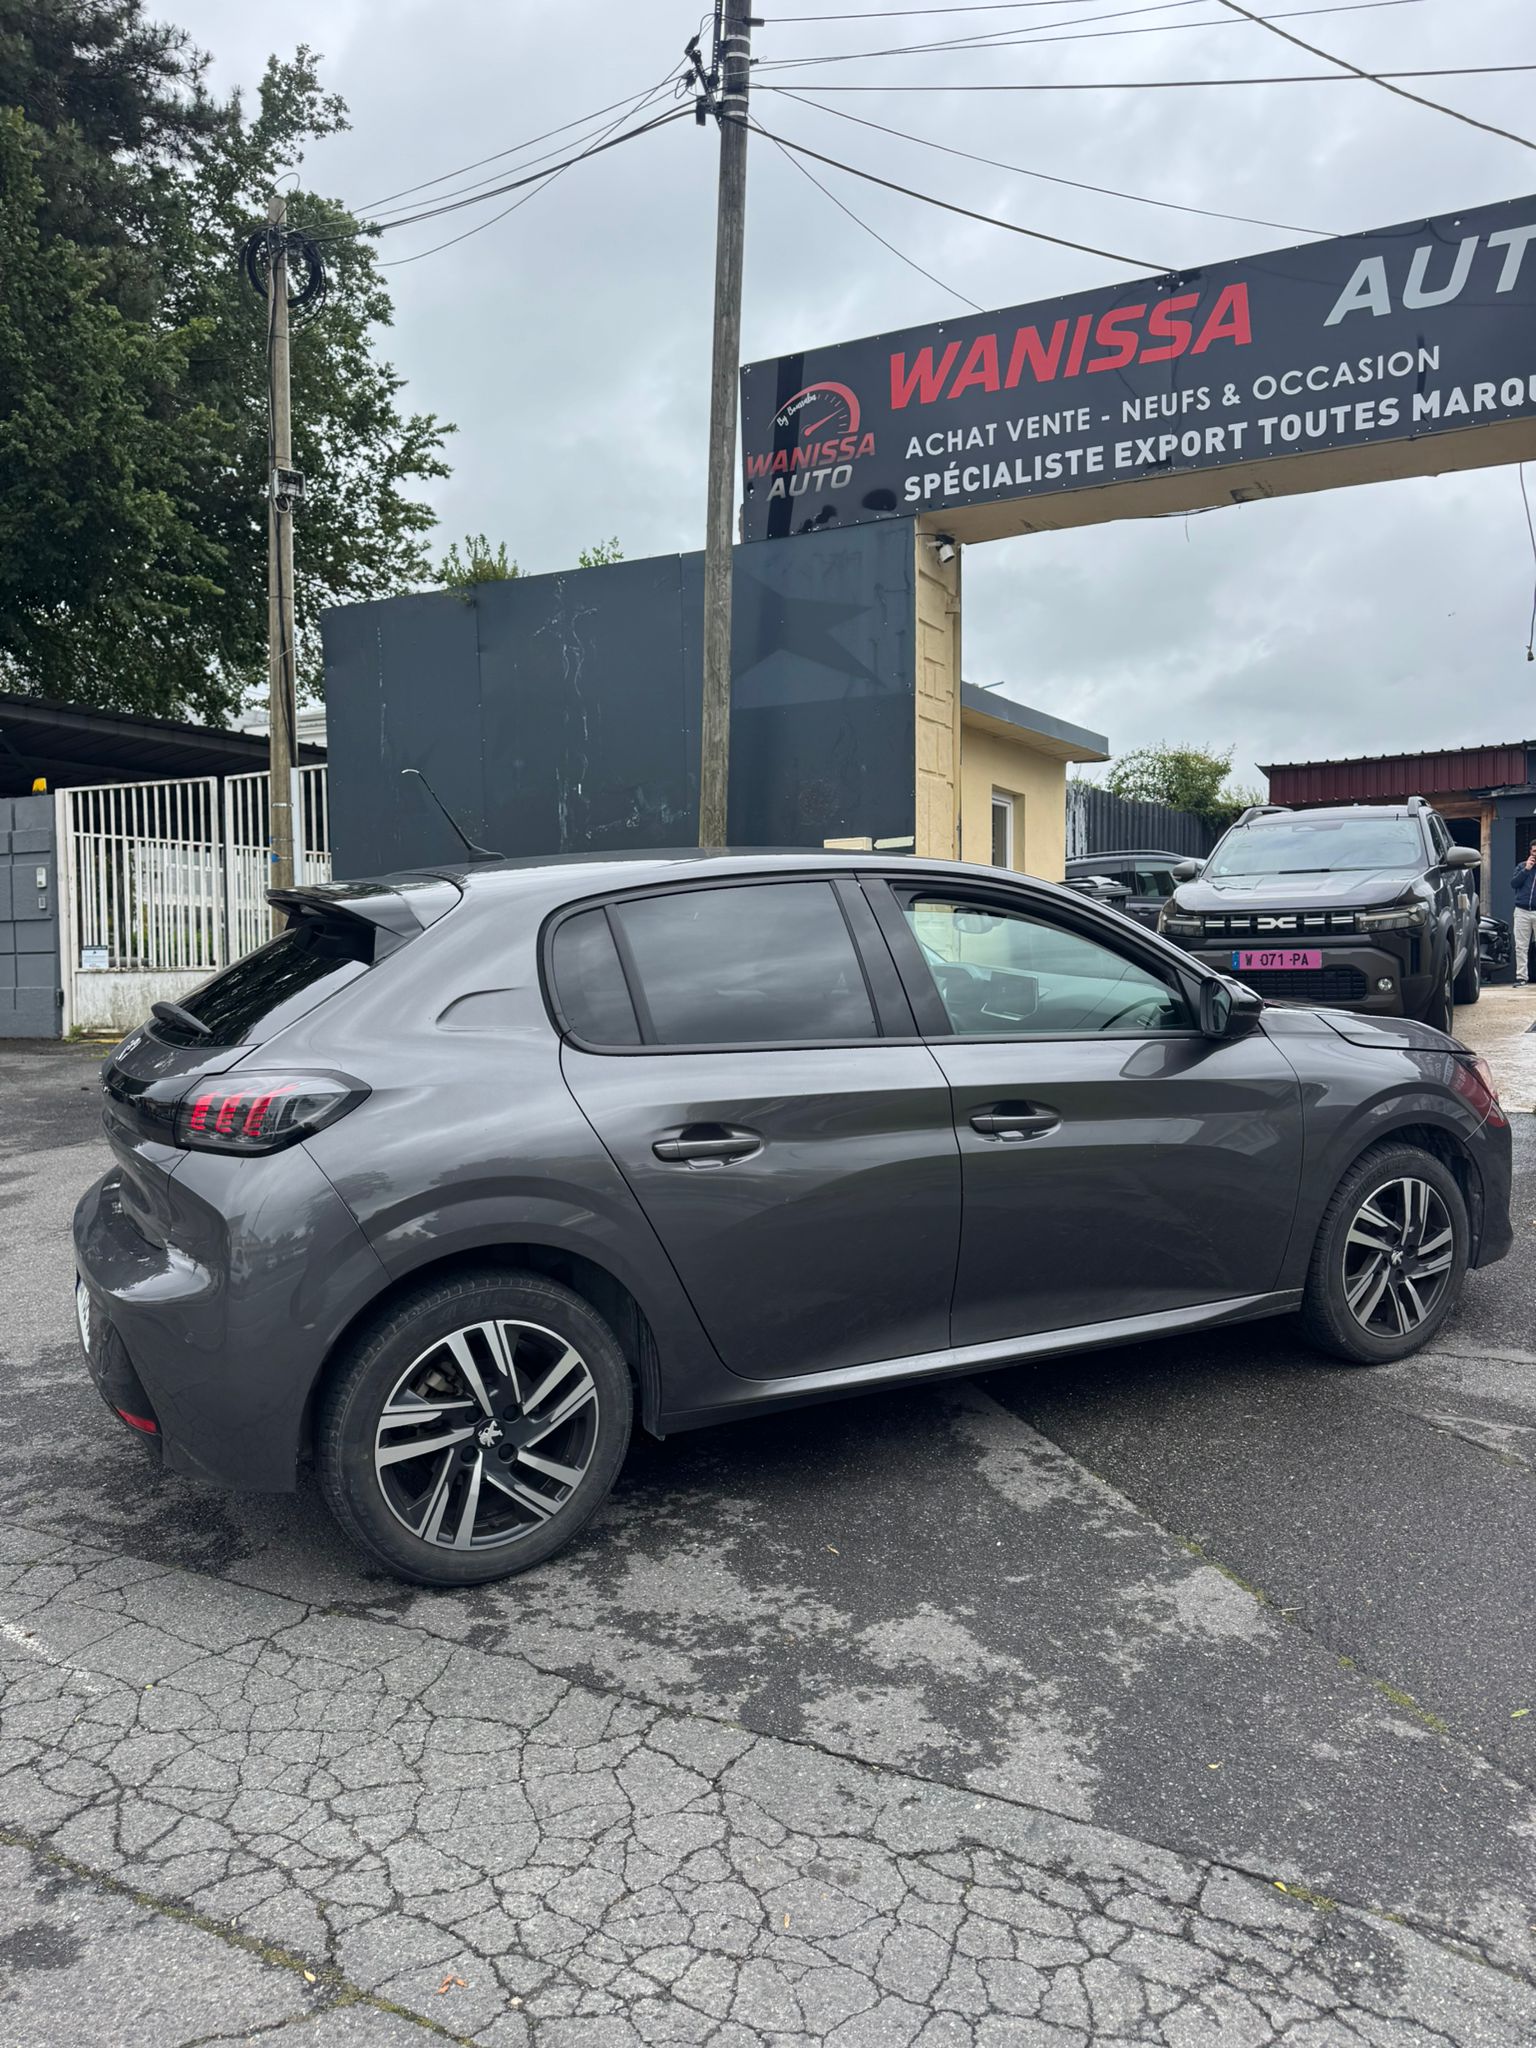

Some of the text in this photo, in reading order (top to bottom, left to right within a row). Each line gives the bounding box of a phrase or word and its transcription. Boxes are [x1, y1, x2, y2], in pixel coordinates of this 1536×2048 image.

[889, 282, 1252, 410] WANISSA
[904, 423, 998, 459] ACHAT
[1006, 407, 1091, 442] VENTE
[1122, 386, 1211, 424] NEUFS
[1222, 383, 1241, 406] &
[1252, 345, 1440, 400] OCCASION
[747, 431, 876, 479] WANISSA
[766, 464, 853, 502] AUTO
[903, 373, 1536, 502] SPÉCIALISTE EXPORT TOUTES MARQ
